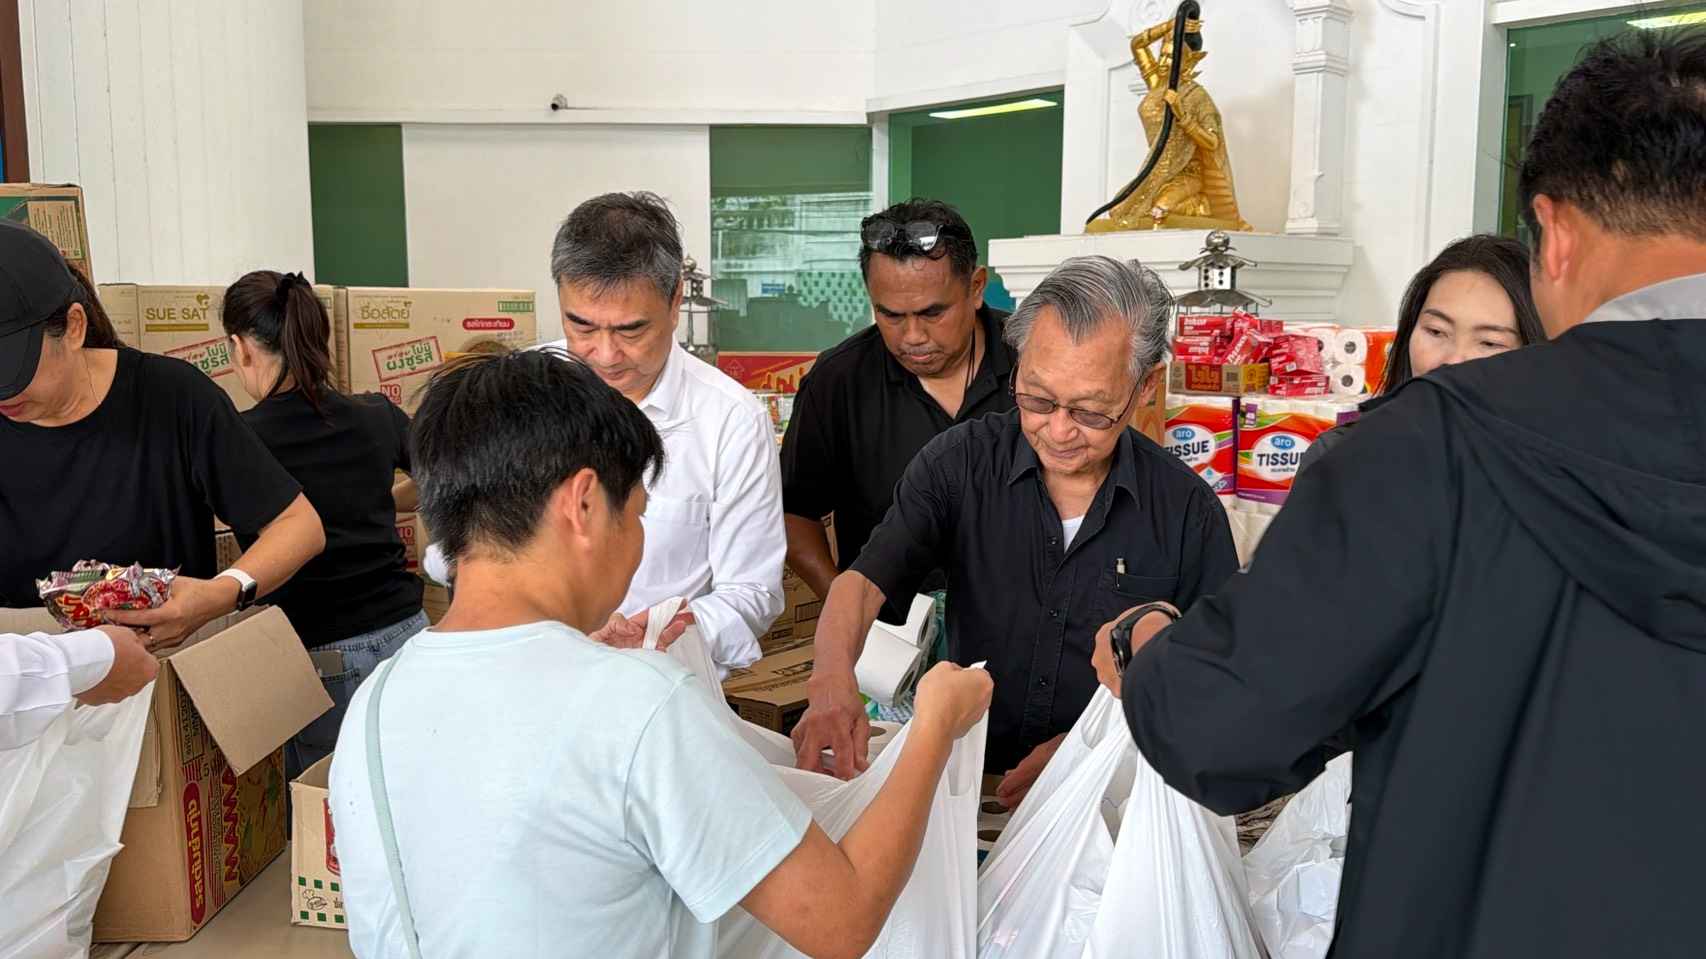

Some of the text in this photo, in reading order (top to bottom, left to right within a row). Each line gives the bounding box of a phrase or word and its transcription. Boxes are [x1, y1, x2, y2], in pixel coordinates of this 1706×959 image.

[145, 307, 208, 320] SUE SAT
[386, 352, 433, 371] ผงชูรส
[1175, 430, 1192, 438] aro
[1274, 437, 1292, 447] aro
[187, 799, 204, 908] รสต้มยำกุ้ง
